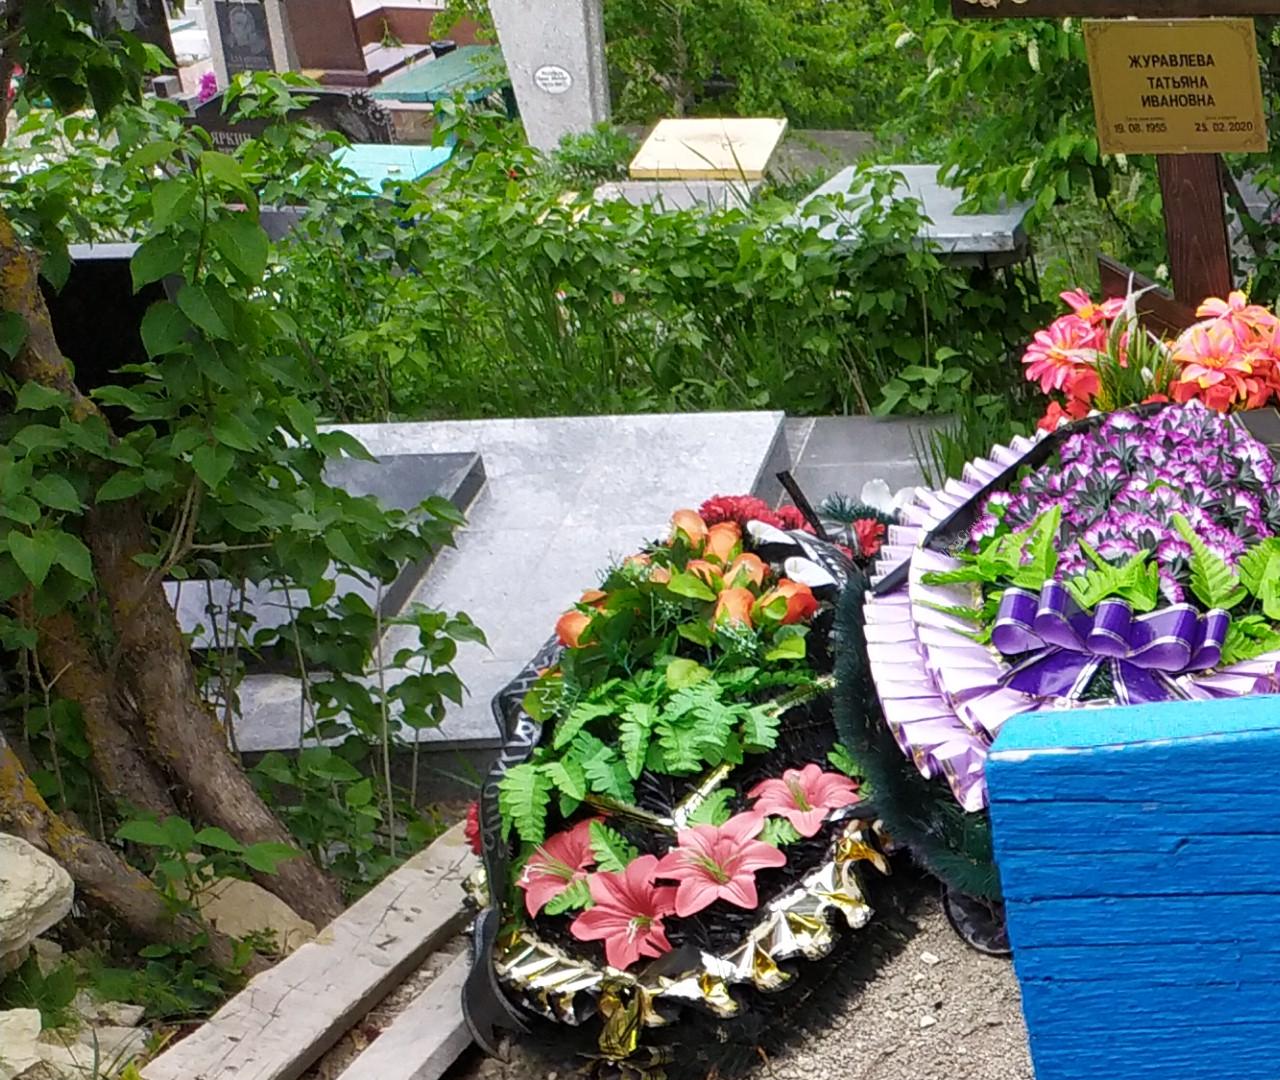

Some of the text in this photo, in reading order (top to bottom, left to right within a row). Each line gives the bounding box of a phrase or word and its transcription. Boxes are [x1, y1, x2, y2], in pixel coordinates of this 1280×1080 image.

[1128, 54, 1215, 68] ЖУРАВЛЕВА
[1147, 76, 1209, 89] ТАТЬЯНА
[1141, 94, 1216, 108] ИВАНОВНА
